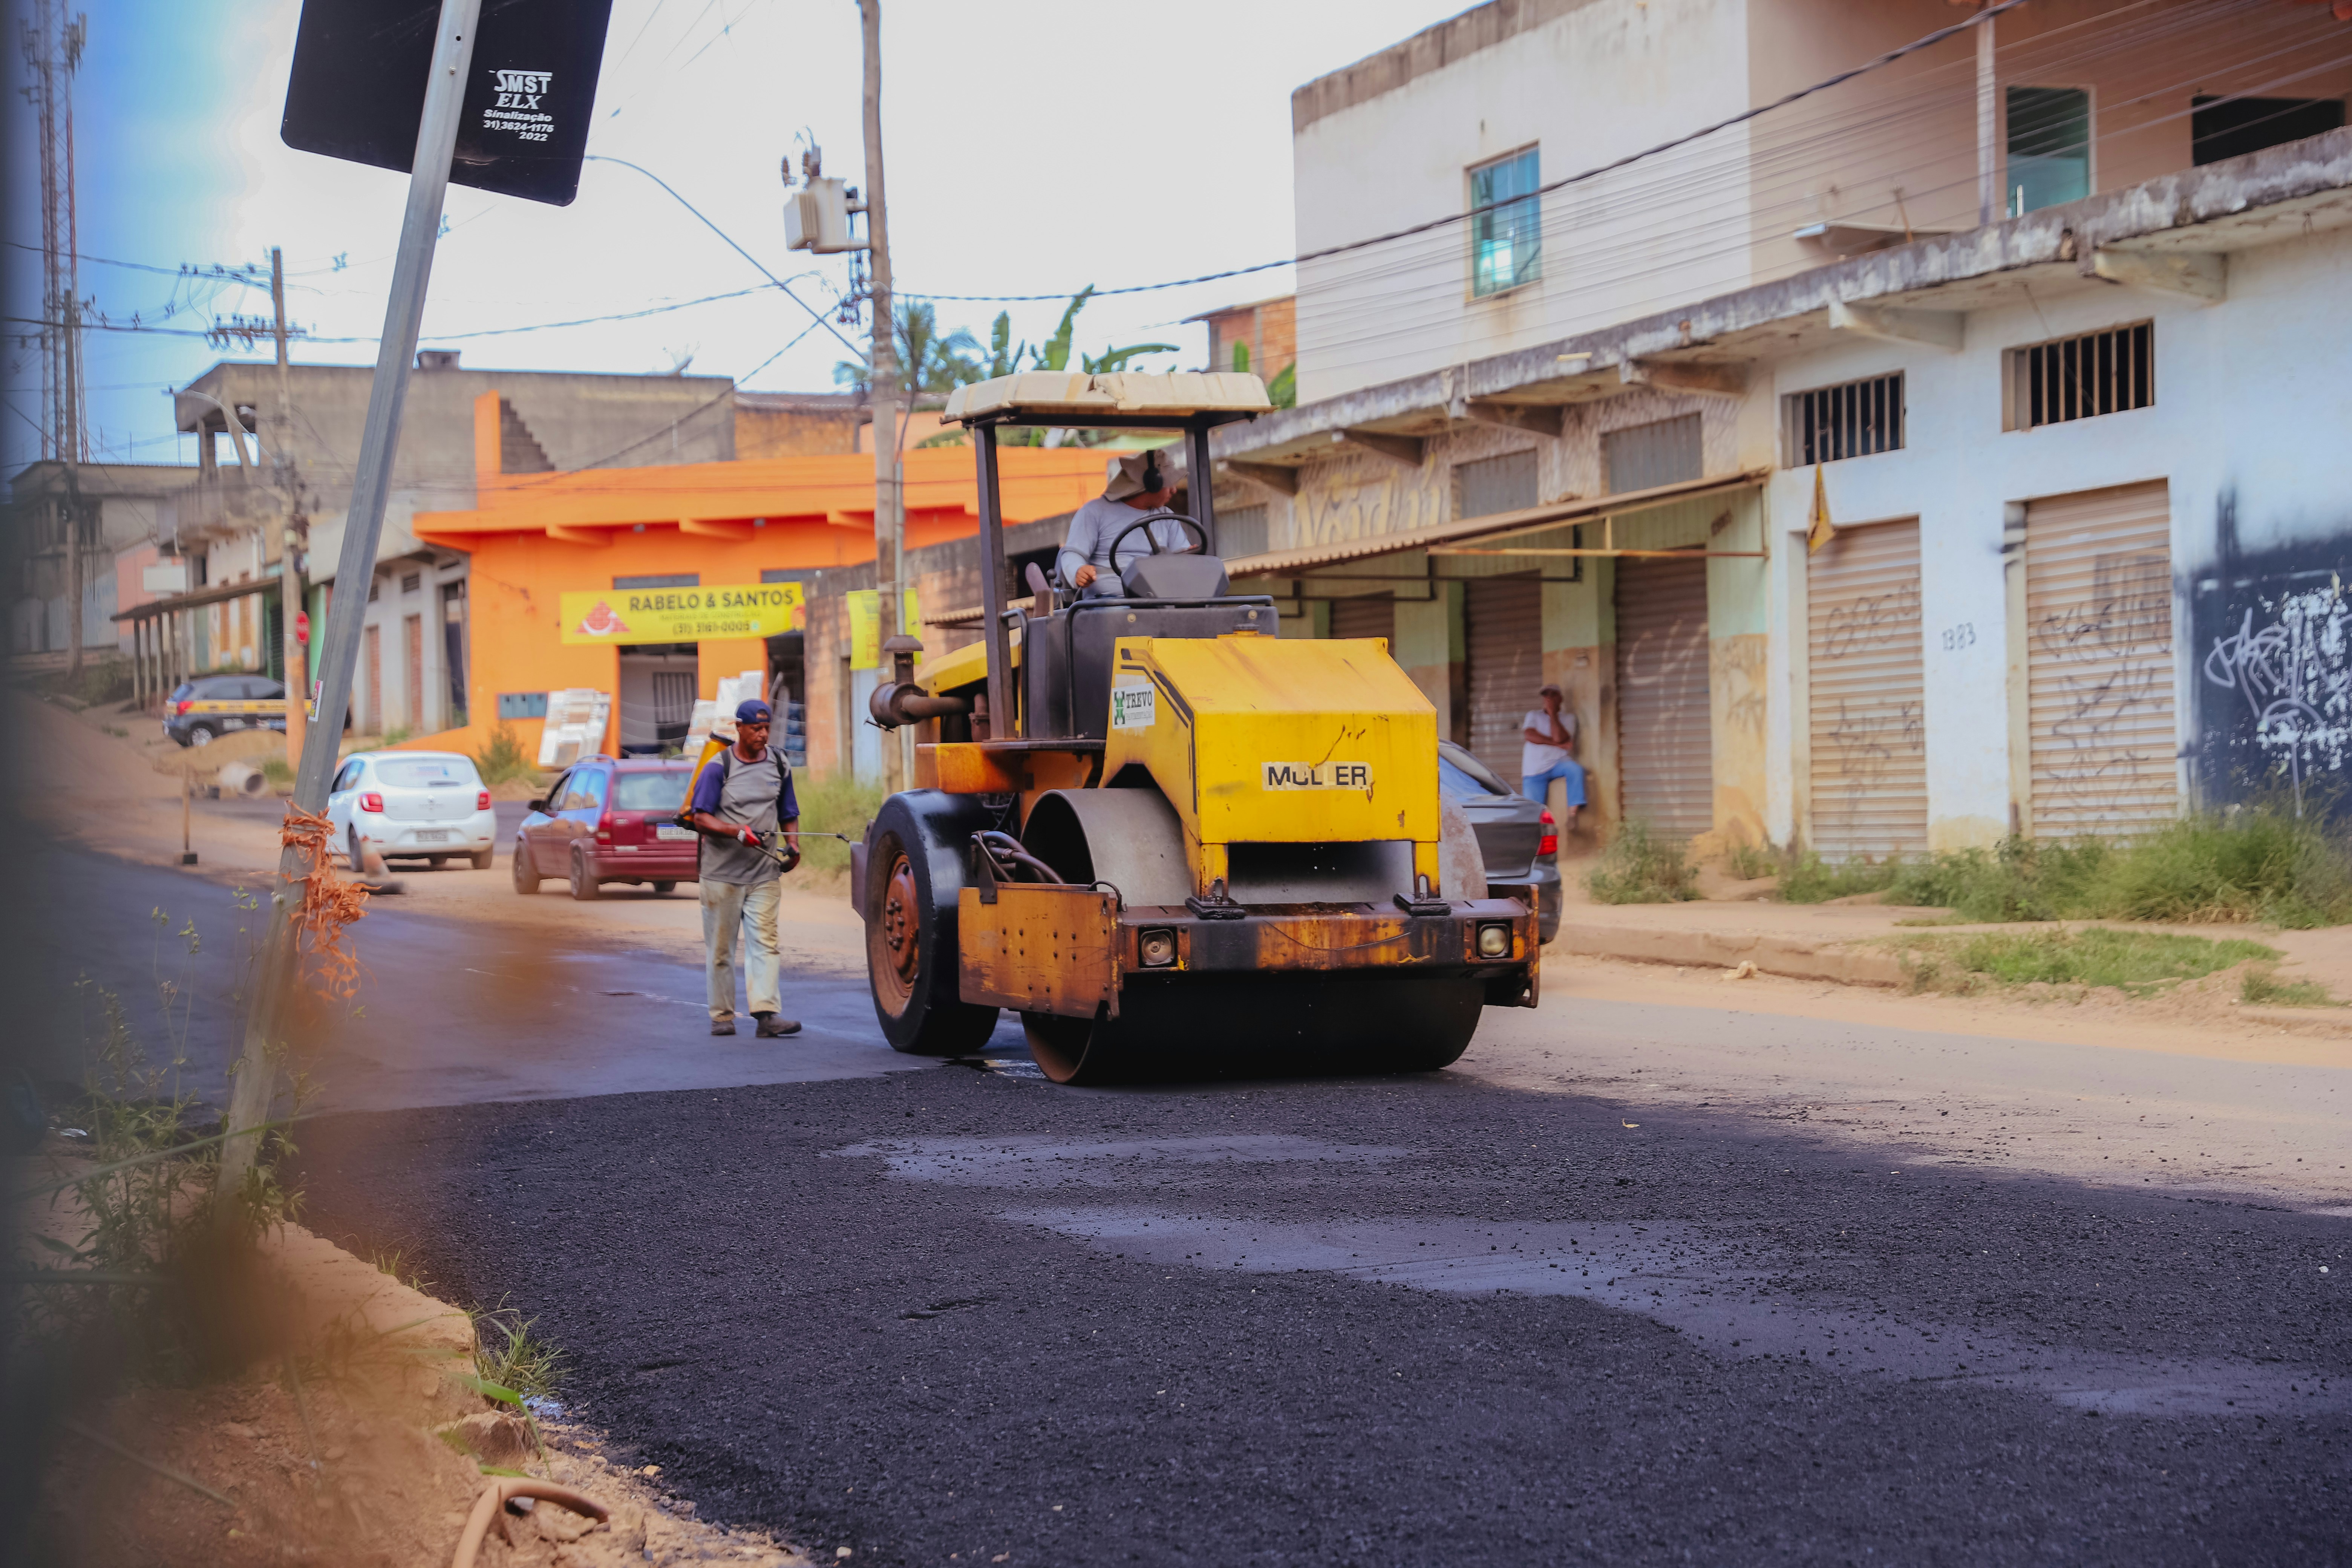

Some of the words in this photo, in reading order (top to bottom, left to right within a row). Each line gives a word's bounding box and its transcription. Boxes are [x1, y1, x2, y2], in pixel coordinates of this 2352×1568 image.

[493, 69, 553, 94] SMST
[495, 93, 543, 110] ELX
[483, 109, 553, 123] Sinalização
[518, 132, 548, 141] 2022
[629, 593, 699, 611] RABELO
[706, 591, 715, 608] &
[723, 590, 793, 607] SANTOS
[1125, 690, 1153, 709] TREVO
